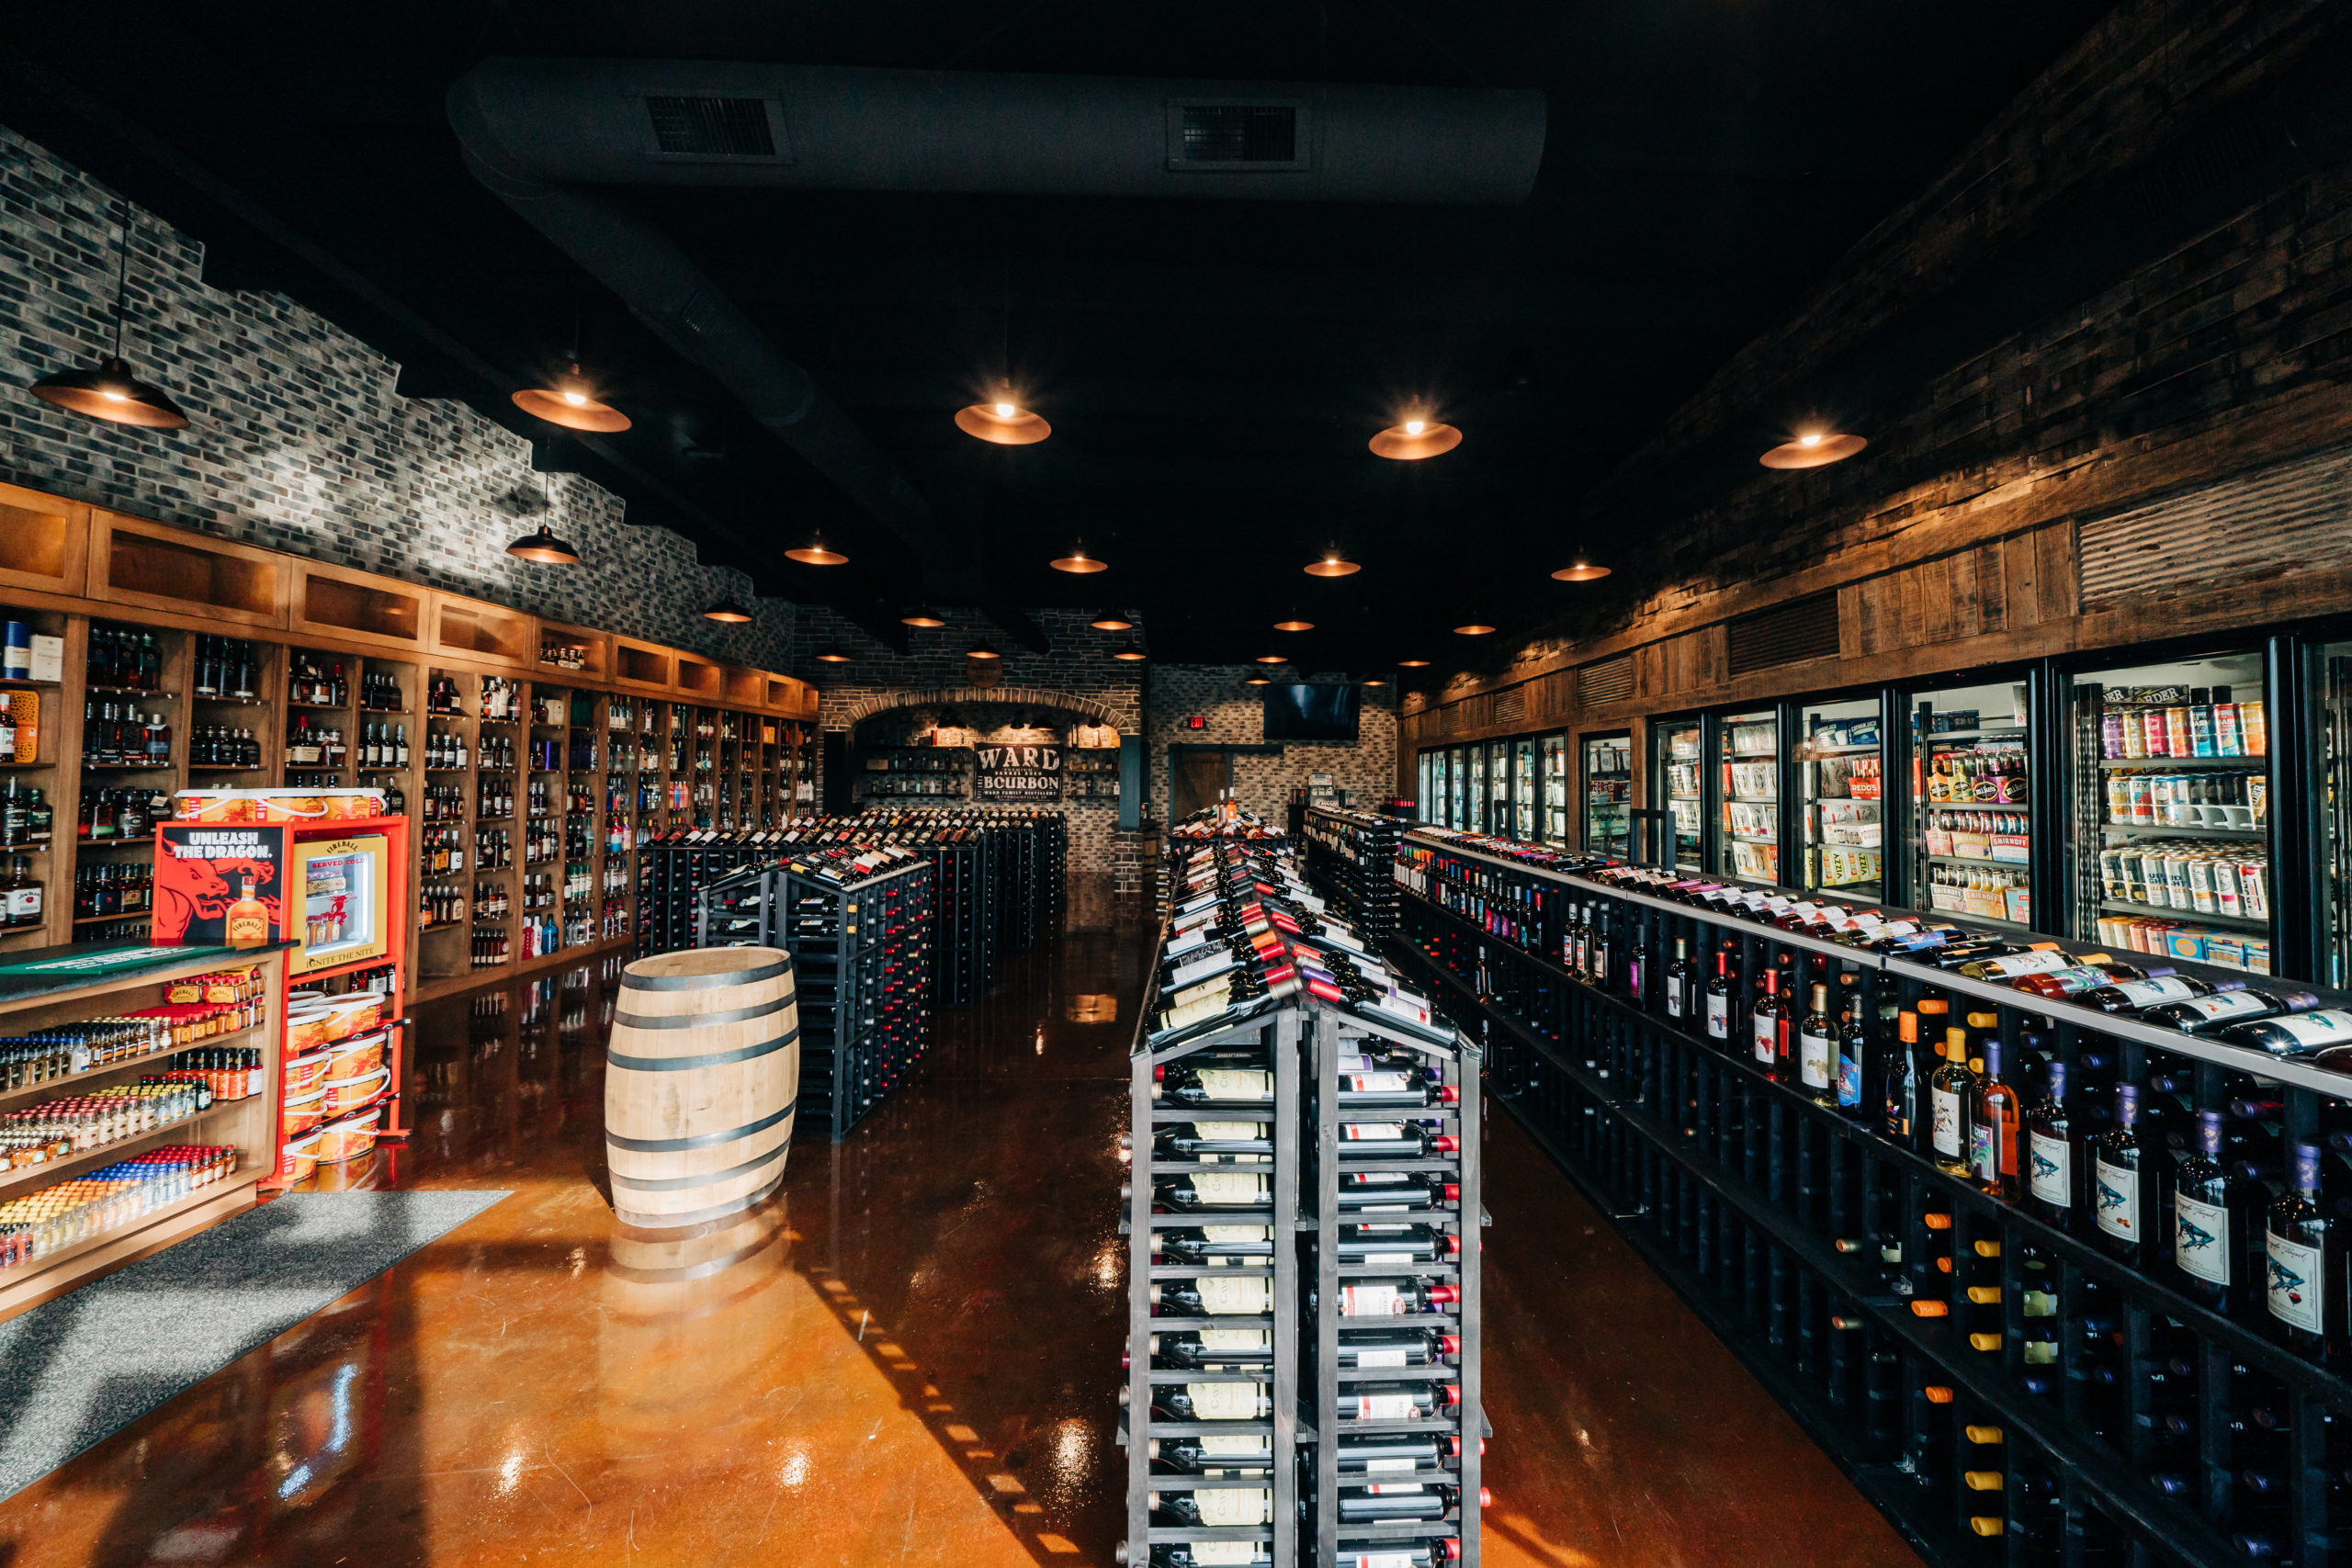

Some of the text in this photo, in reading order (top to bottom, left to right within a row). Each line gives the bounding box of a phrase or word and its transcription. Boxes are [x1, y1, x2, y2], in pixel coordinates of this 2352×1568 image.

[1191, 717, 1204, 728] EXIT
[977, 746, 1060, 771] WARD
[983, 776, 1059, 790] BOURBON
[1851, 784, 1877, 792] REDD'S
[188, 831, 259, 845] UNLEASH
[1993, 837, 2026, 847] SMIRNOFF
[173, 845, 273, 858] THE DRAGON.
[326, 840, 358, 854] FIREBALL
[311, 858, 344, 869] SERVED
[1833, 852, 1843, 879] VIZZY
[1858, 852, 1868, 876] VIZZY
[1966, 890, 1998, 902] SMIRNOFF
[232, 920, 263, 932] FIREBALL
[306, 947, 374, 969] IGNITE THE NITE
